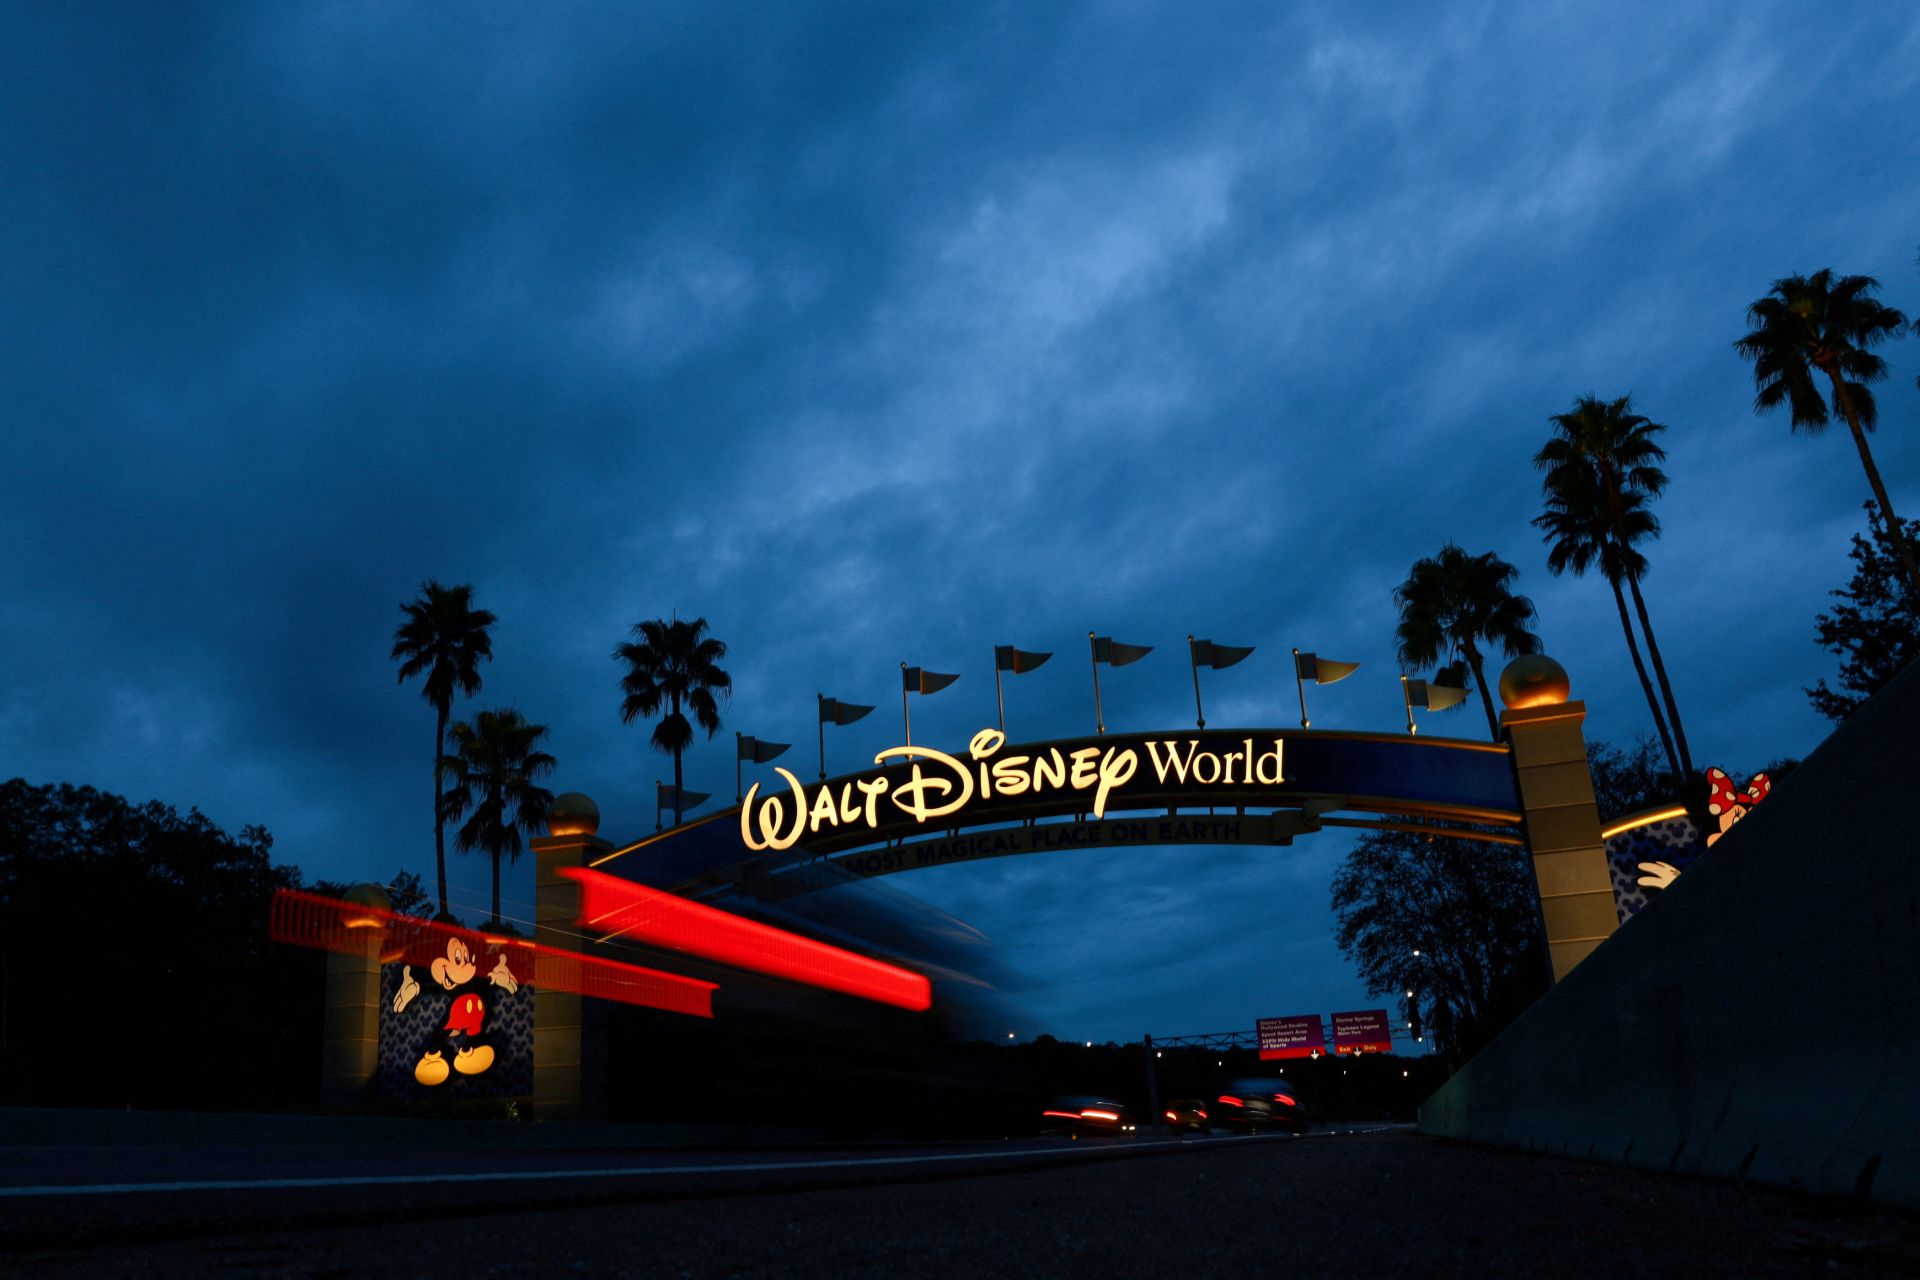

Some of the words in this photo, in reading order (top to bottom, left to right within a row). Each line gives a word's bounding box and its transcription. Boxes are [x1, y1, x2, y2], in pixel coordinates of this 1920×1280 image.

[1144, 738, 1286, 787] World
[846, 850, 906, 874] MOST
[916, 834, 1021, 865] MAGICAL
[1031, 825, 1101, 848] PLACE
[1110, 823, 1147, 841] ON
[1159, 821, 1241, 840] EARTH
